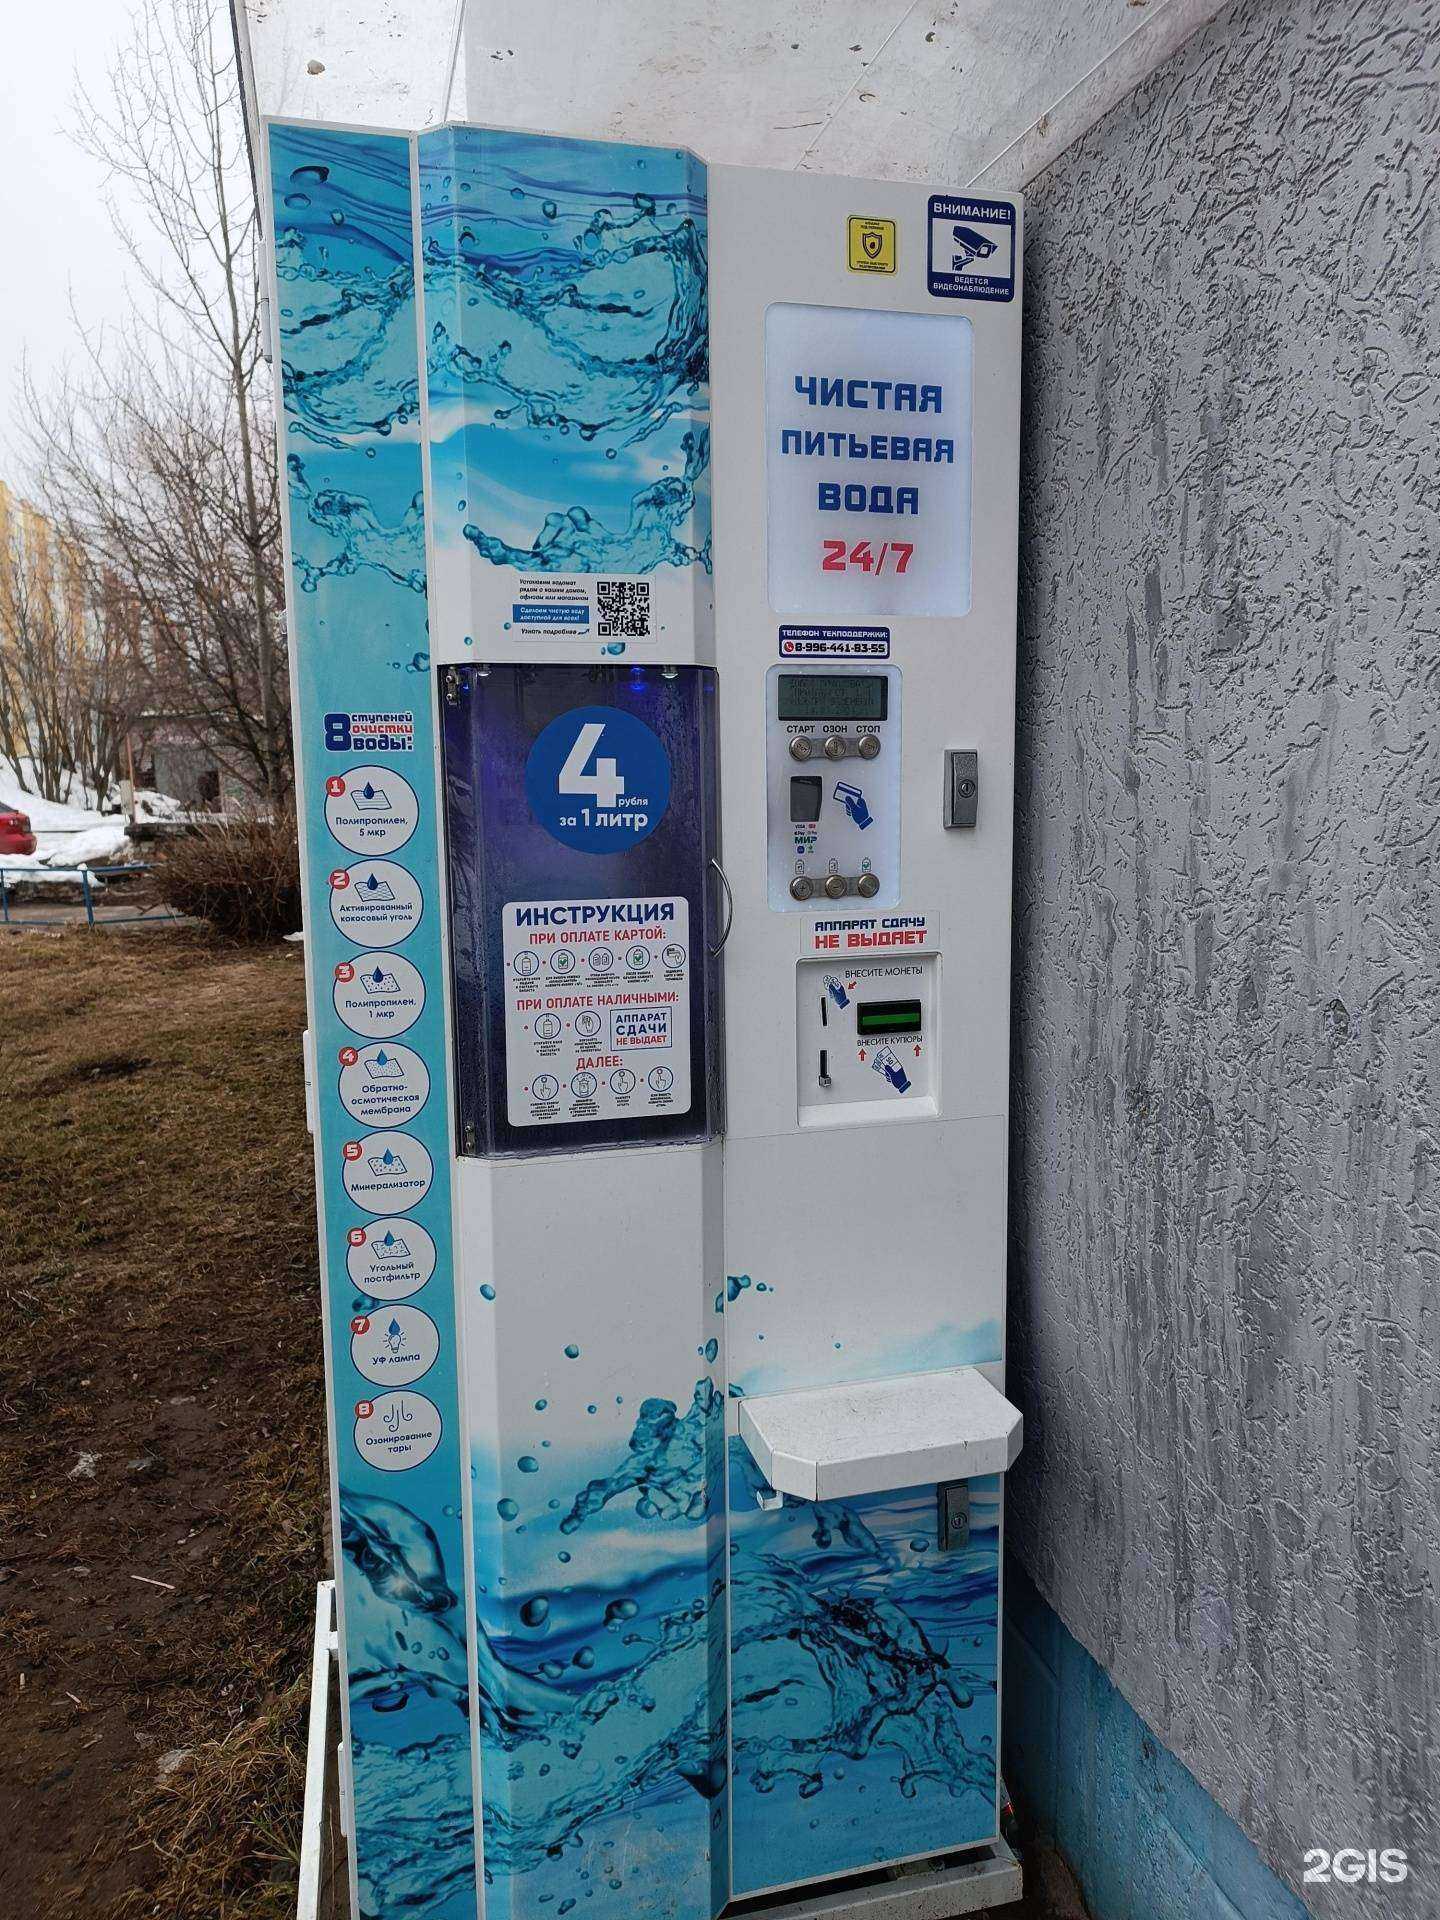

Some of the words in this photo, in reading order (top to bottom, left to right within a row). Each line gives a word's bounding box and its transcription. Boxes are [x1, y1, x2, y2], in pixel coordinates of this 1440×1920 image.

[933, 202, 1011, 220] ВНИМАНИЕ!
[954, 276, 989, 285] ВЕДЕТСЯ
[933, 282, 1009, 295] ВИДЕОНАБЛЮДЕНИЕ
[794, 375, 942, 414] ЧИСТАЯ
[781, 429, 954, 464] ПИТЬЕВАЯ
[818, 482, 919, 515] ВОДА
[822, 540, 914, 576] 24/7
[782, 629, 820, 637] ТЕЛЕФОН
[351, 712, 413, 724] ступеней
[324, 713, 352, 751] 8
[352, 724, 413, 734] очистки
[786, 725, 816, 733] СТАРТ
[822, 725, 848, 733] ОЗОН
[856, 725, 881, 733] СТОП
[558, 723, 625, 808] 4
[618, 797, 648, 807] рубля
[330, 780, 341, 793] 1
[335, 817, 408, 826] Полипропилен,
[559, 816, 577, 827] за
[581, 808, 590, 827] 1
[595, 813, 648, 832] литр
[359, 829, 365, 837] 5
[367, 829, 386, 838] мкр
[334, 872, 346, 886] 2
[339, 902, 413, 913] Активированный
[340, 913, 388, 922] кокосовый
[389, 914, 413, 922] уголь
[516, 902, 674, 927] ИНСТРУКЦИЯ
[814, 919, 877, 932] АППАРАТ
[882, 917, 925, 929] СДАЧУ
[529, 932, 556, 945] ПРИ
[560, 930, 610, 944] ОПЛАТЕ
[614, 926, 667, 941] КАРТОЙ:
[815, 934, 840, 949] НЕ
[847, 930, 928, 948] ВЫДАЕТ
[338, 965, 351, 978] 3
[845, 968, 883, 979] ВНЕСИТЕ
[884, 966, 923, 977] МОНЕТЫ
[516, 999, 542, 1011] ПРИ
[546, 995, 593, 1009] ОПЛАТЕ
[597, 991, 679, 1006] НАЛИЧНЫМИ:
[376, 1010, 395, 1019] мкр
[615, 1012, 667, 1024] АППАРАТ
[616, 1024, 667, 1036] СДАЧИ
[616, 1037, 629, 1046] НЕ
[630, 1035, 668, 1045] ВЫДАЕТ
[857, 1037, 889, 1047] ВНЕСИТЕ
[890, 1035, 923, 1045] КУПЮРЫ
[342, 1049, 355, 1063] 4
[575, 1055, 624, 1072] ДАЛЕЕ:
[361, 1084, 408, 1094] Обратно-
[351, 1094, 420, 1105] осмотическая
[360, 1105, 411, 1116] мембрана
[346, 1144, 359, 1157] 5
[351, 1180, 426, 1192] Минерализатор
[369, 1261, 414, 1273] Угольный
[364, 1272, 421, 1284] постфильтр
[354, 1319, 366, 1332] 7
[388, 1353, 420, 1364] лампа
[365, 1431, 433, 1446] Озонирование
[388, 1445, 412, 1454] тары
